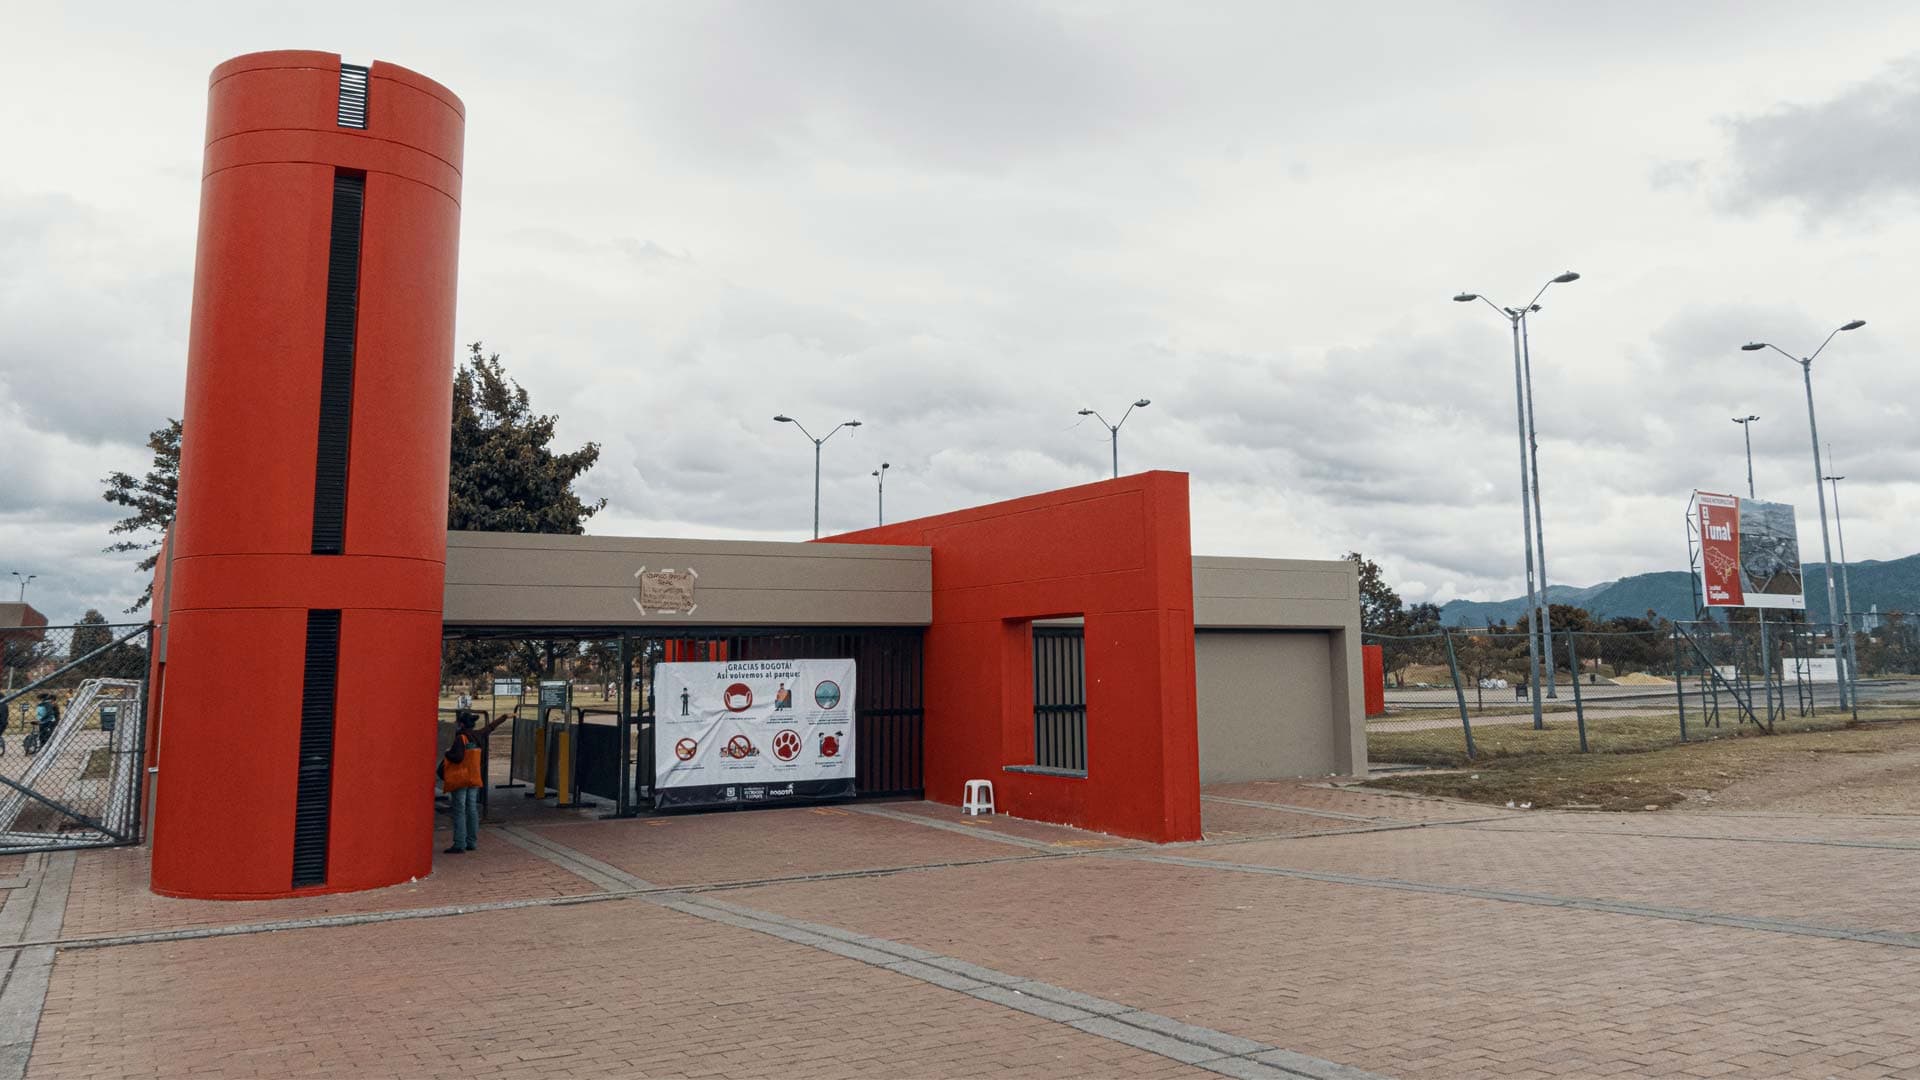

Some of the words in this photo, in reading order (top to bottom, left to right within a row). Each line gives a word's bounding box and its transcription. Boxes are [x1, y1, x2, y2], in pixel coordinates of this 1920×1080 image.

[1702, 519, 1731, 541] Tunal
[761, 661, 792, 671] BOGOTÁ!
[717, 671, 728, 680] Así
[774, 671, 801, 680] parque:
